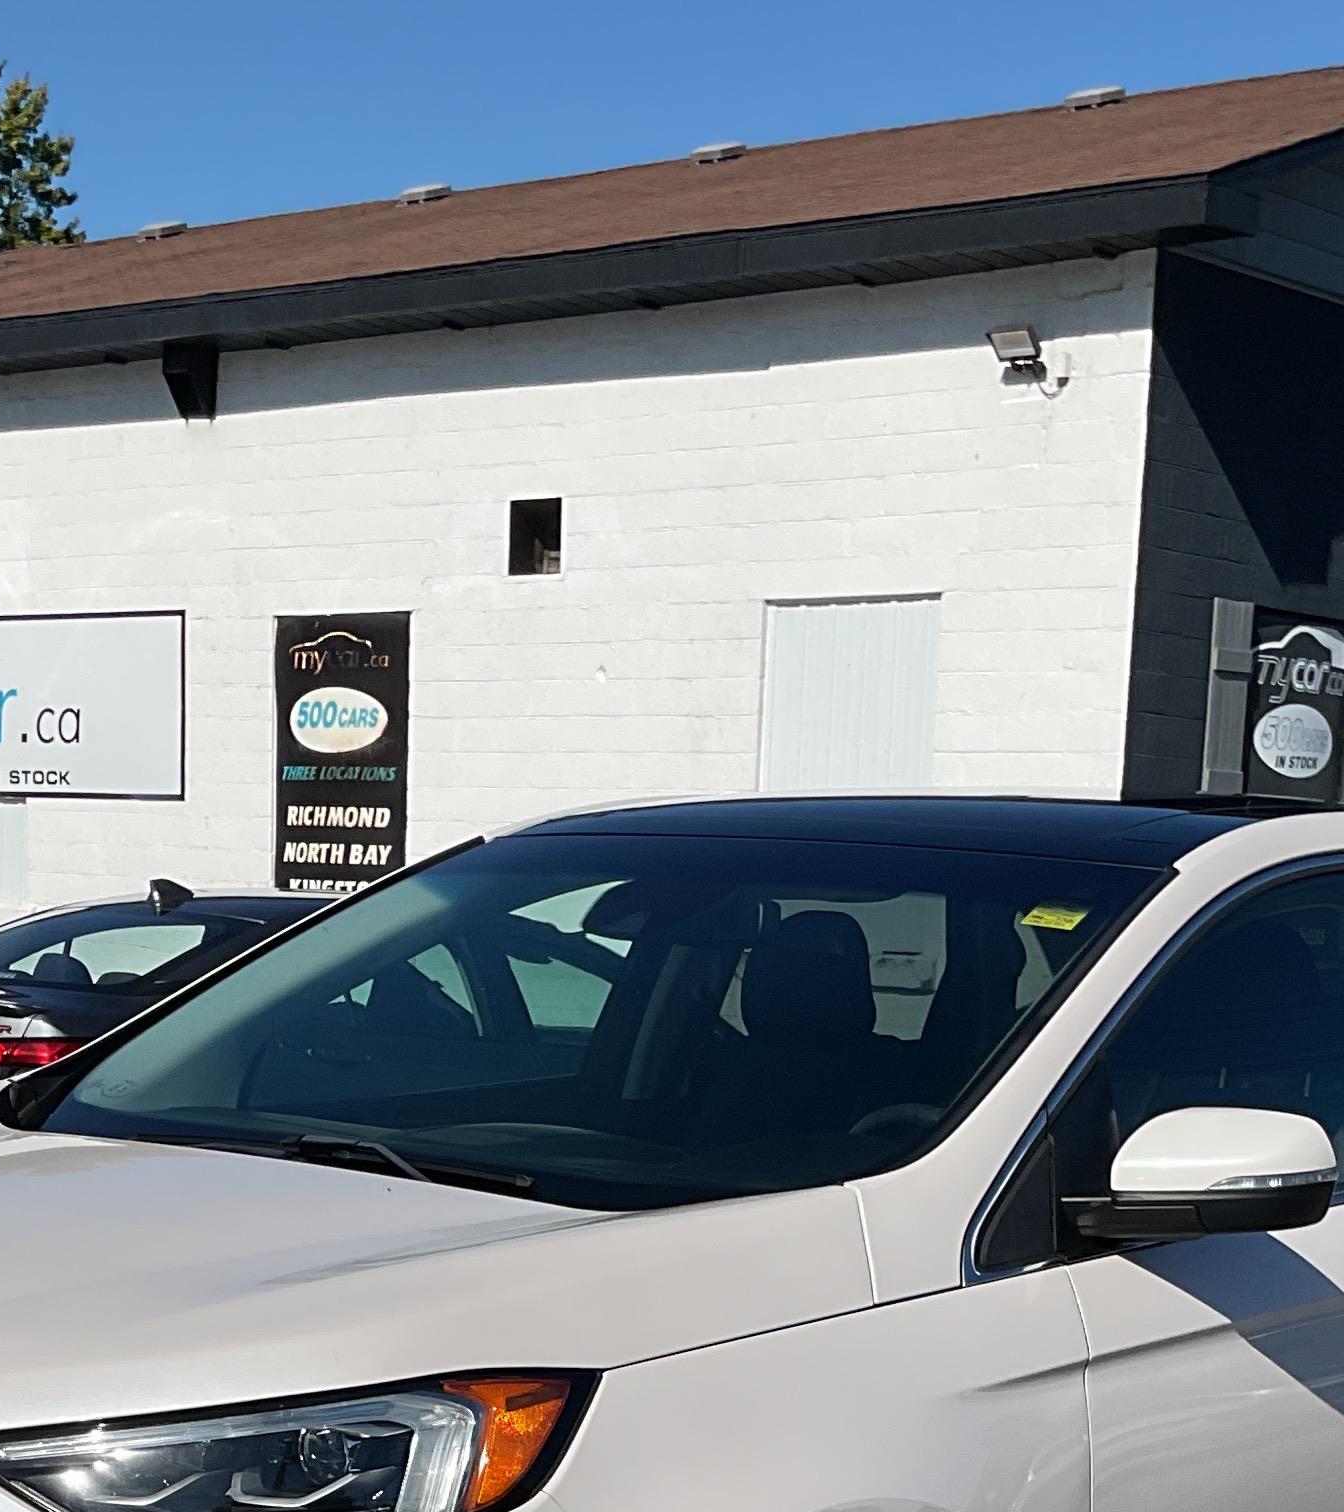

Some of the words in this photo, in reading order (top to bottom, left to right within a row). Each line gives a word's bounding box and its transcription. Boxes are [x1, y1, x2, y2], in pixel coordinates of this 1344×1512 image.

[1275, 755, 1287, 769] IN
[1289, 755, 1319, 770] STOCK
[9, 770, 71, 786] STOCK
[281, 765, 318, 781] THREE
[319, 766, 399, 782] LOCATIONS
[286, 805, 391, 828] RICHMOND
[283, 842, 345, 865] NORTH
[348, 844, 393, 866] BAY
